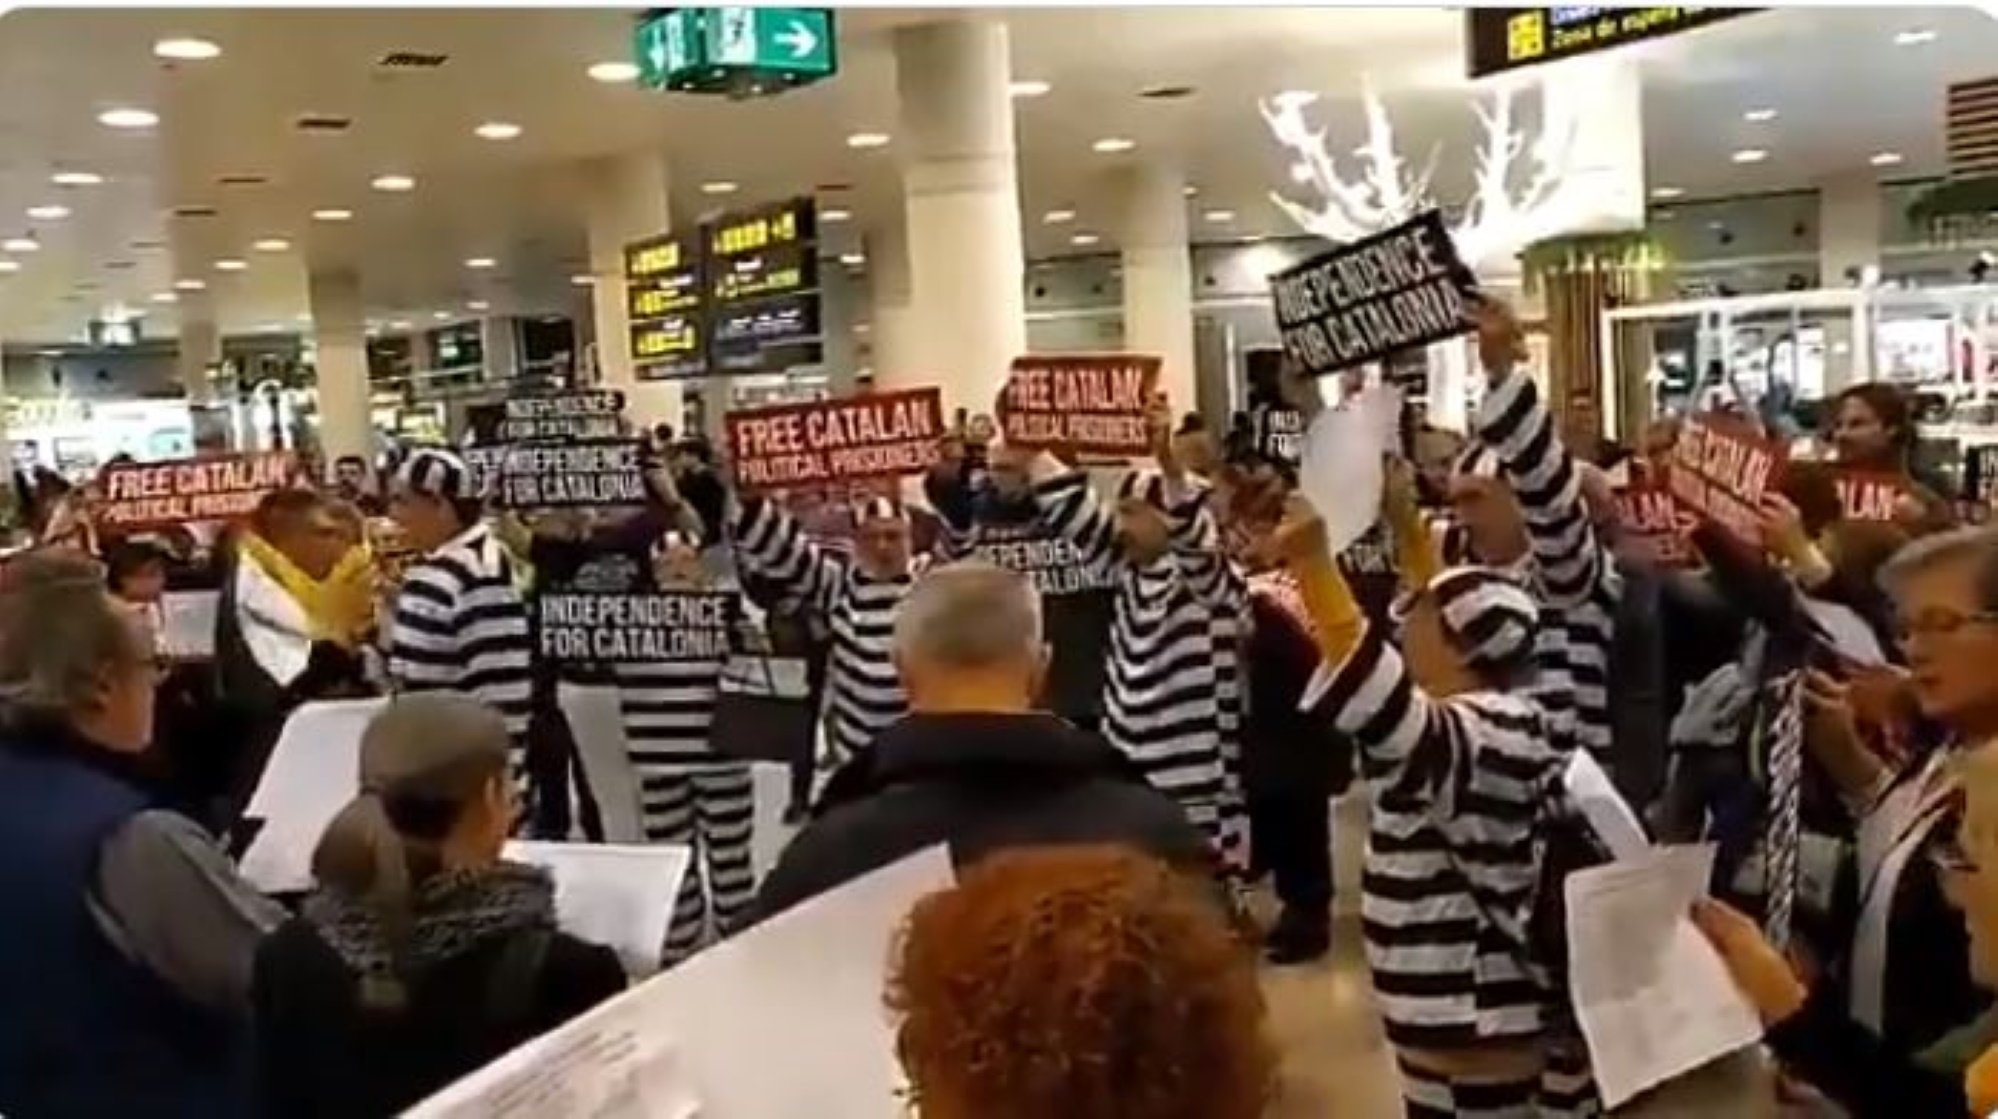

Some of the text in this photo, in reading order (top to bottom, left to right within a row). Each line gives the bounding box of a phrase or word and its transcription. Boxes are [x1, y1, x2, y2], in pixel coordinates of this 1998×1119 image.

[1276, 227, 1447, 326] INDEPENDENCE
[1324, 278, 1464, 360] CATALONIA
[1008, 366, 1143, 410] FREE CATALAN
[736, 399, 932, 457] FREE CATALAN
[109, 454, 287, 500] FREE CATALAN
[504, 443, 642, 473] INDEPENDENCE
[737, 438, 942, 484] POLITICAL PRISONERS
[504, 475, 538, 504] FOR
[541, 472, 648, 502] CATALONIA
[541, 595, 729, 626] INDEPENDENCE
[541, 627, 730, 659] FOR CATALONIA
